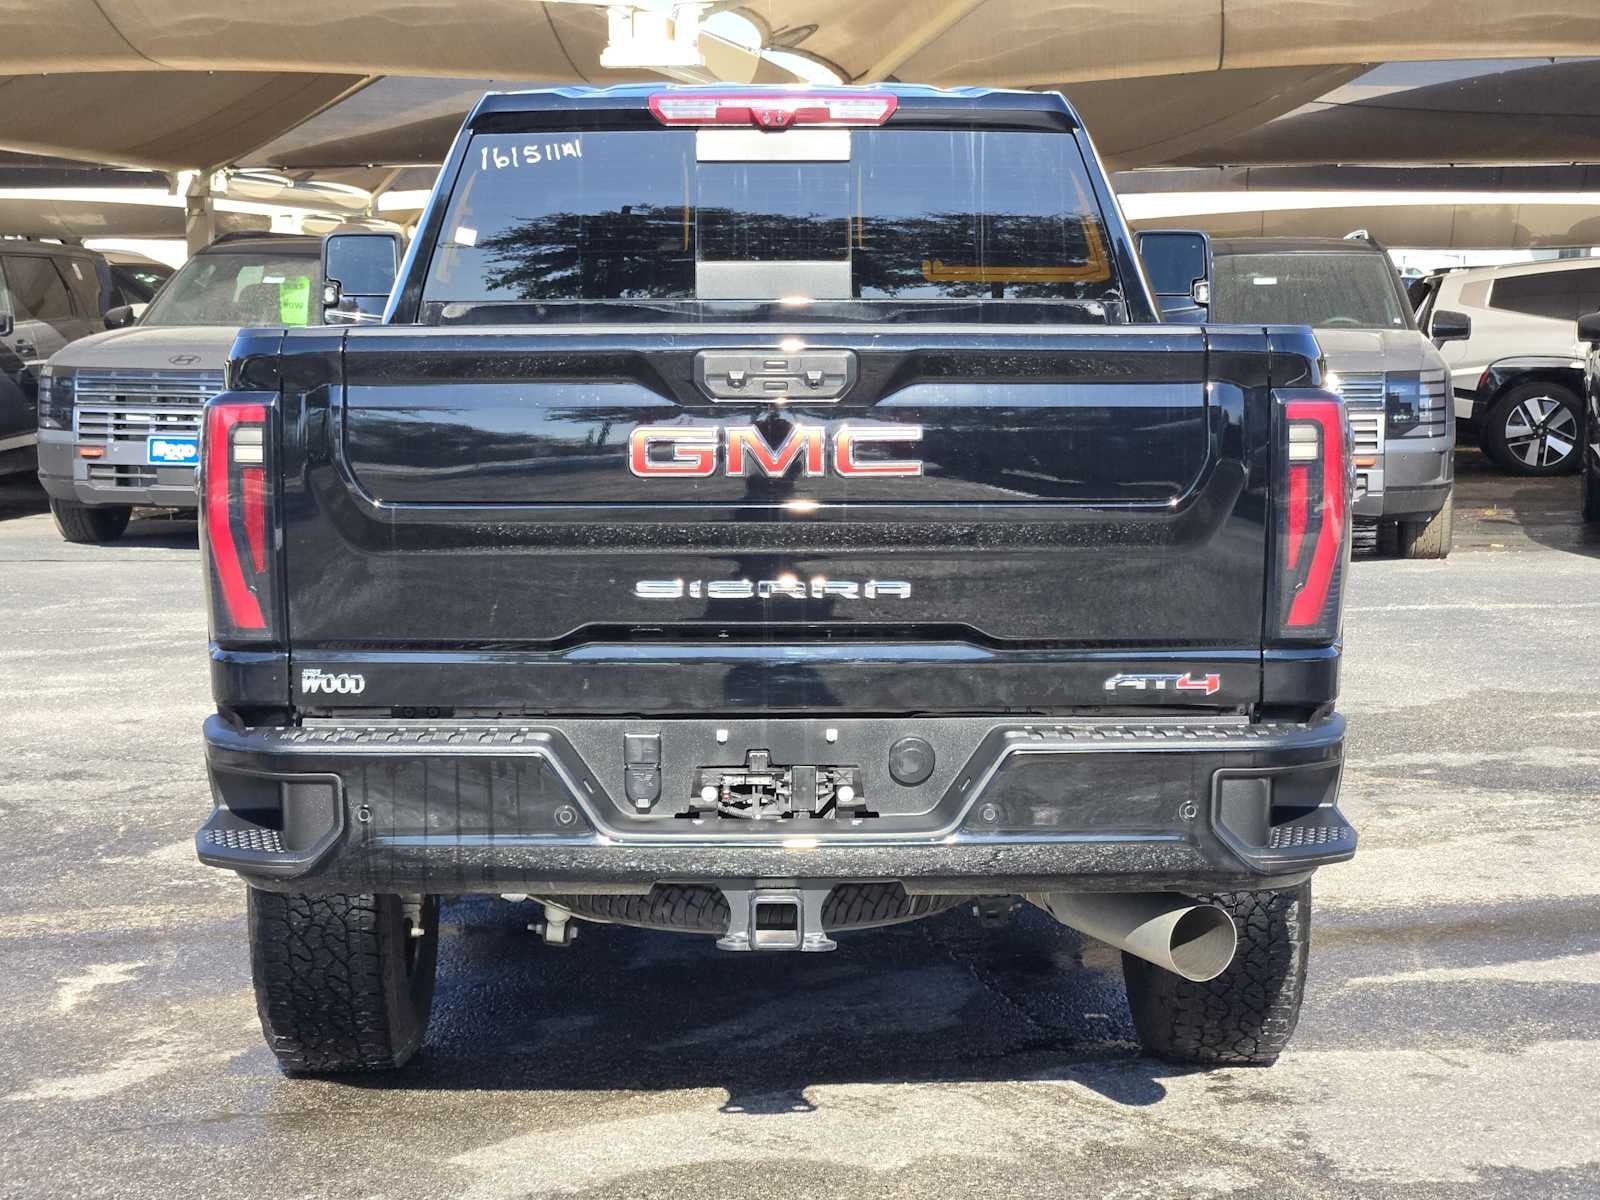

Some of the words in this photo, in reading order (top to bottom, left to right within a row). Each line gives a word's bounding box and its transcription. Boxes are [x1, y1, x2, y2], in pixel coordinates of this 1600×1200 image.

[629, 425, 923, 478] GMC
[634, 578, 911, 599] SIERRA
[302, 671, 365, 693] WOOD
[1105, 673, 1220, 695] AT4
